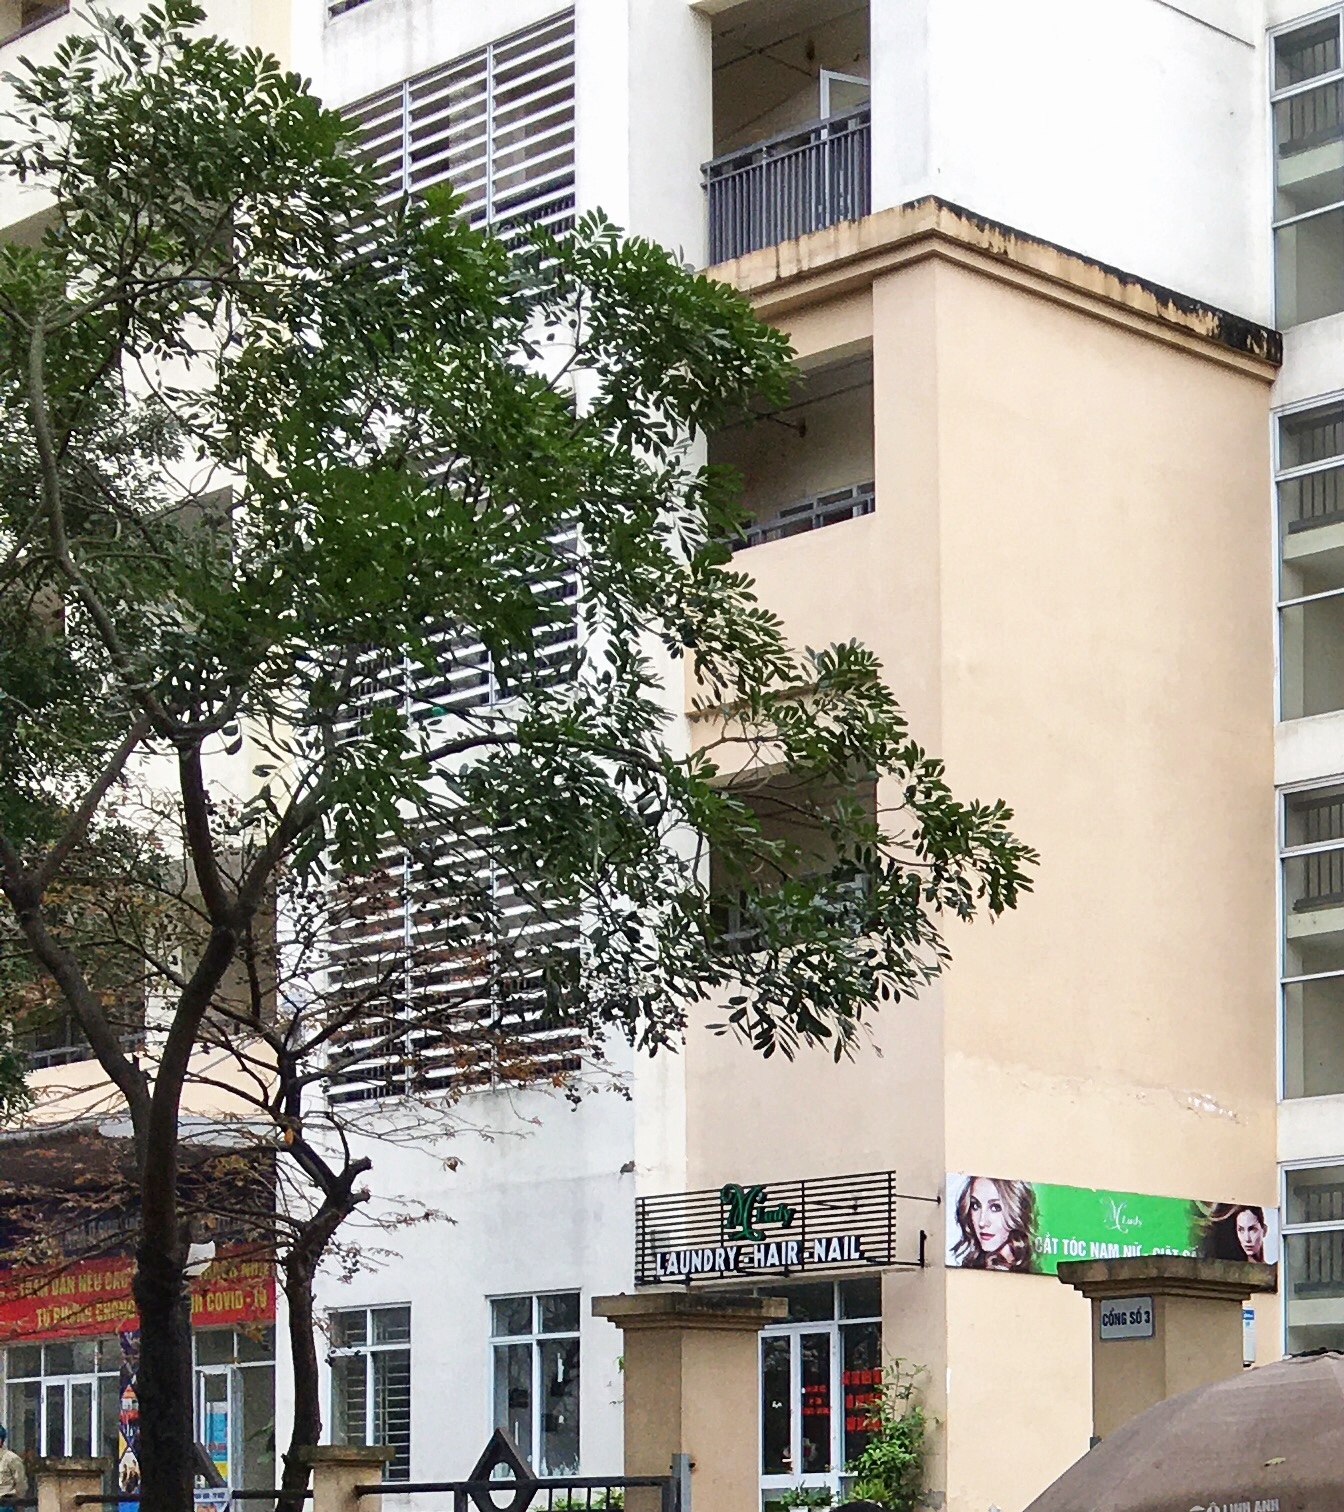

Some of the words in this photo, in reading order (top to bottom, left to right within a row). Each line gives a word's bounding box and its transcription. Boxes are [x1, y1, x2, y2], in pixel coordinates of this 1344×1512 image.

[656, 1246, 738, 1276] LAUNDRY
[753, 1241, 798, 1268] HAIR
[813, 1235, 860, 1262] NAIL
[1062, 1237, 1087, 1257] TÓC
[1090, 1242, 1120, 1258] NAM
[206, 1290, 244, 1312] COVID
[1144, 1310, 1151, 1324] 3
[1254, 1499, 1280, 1512] ANH
